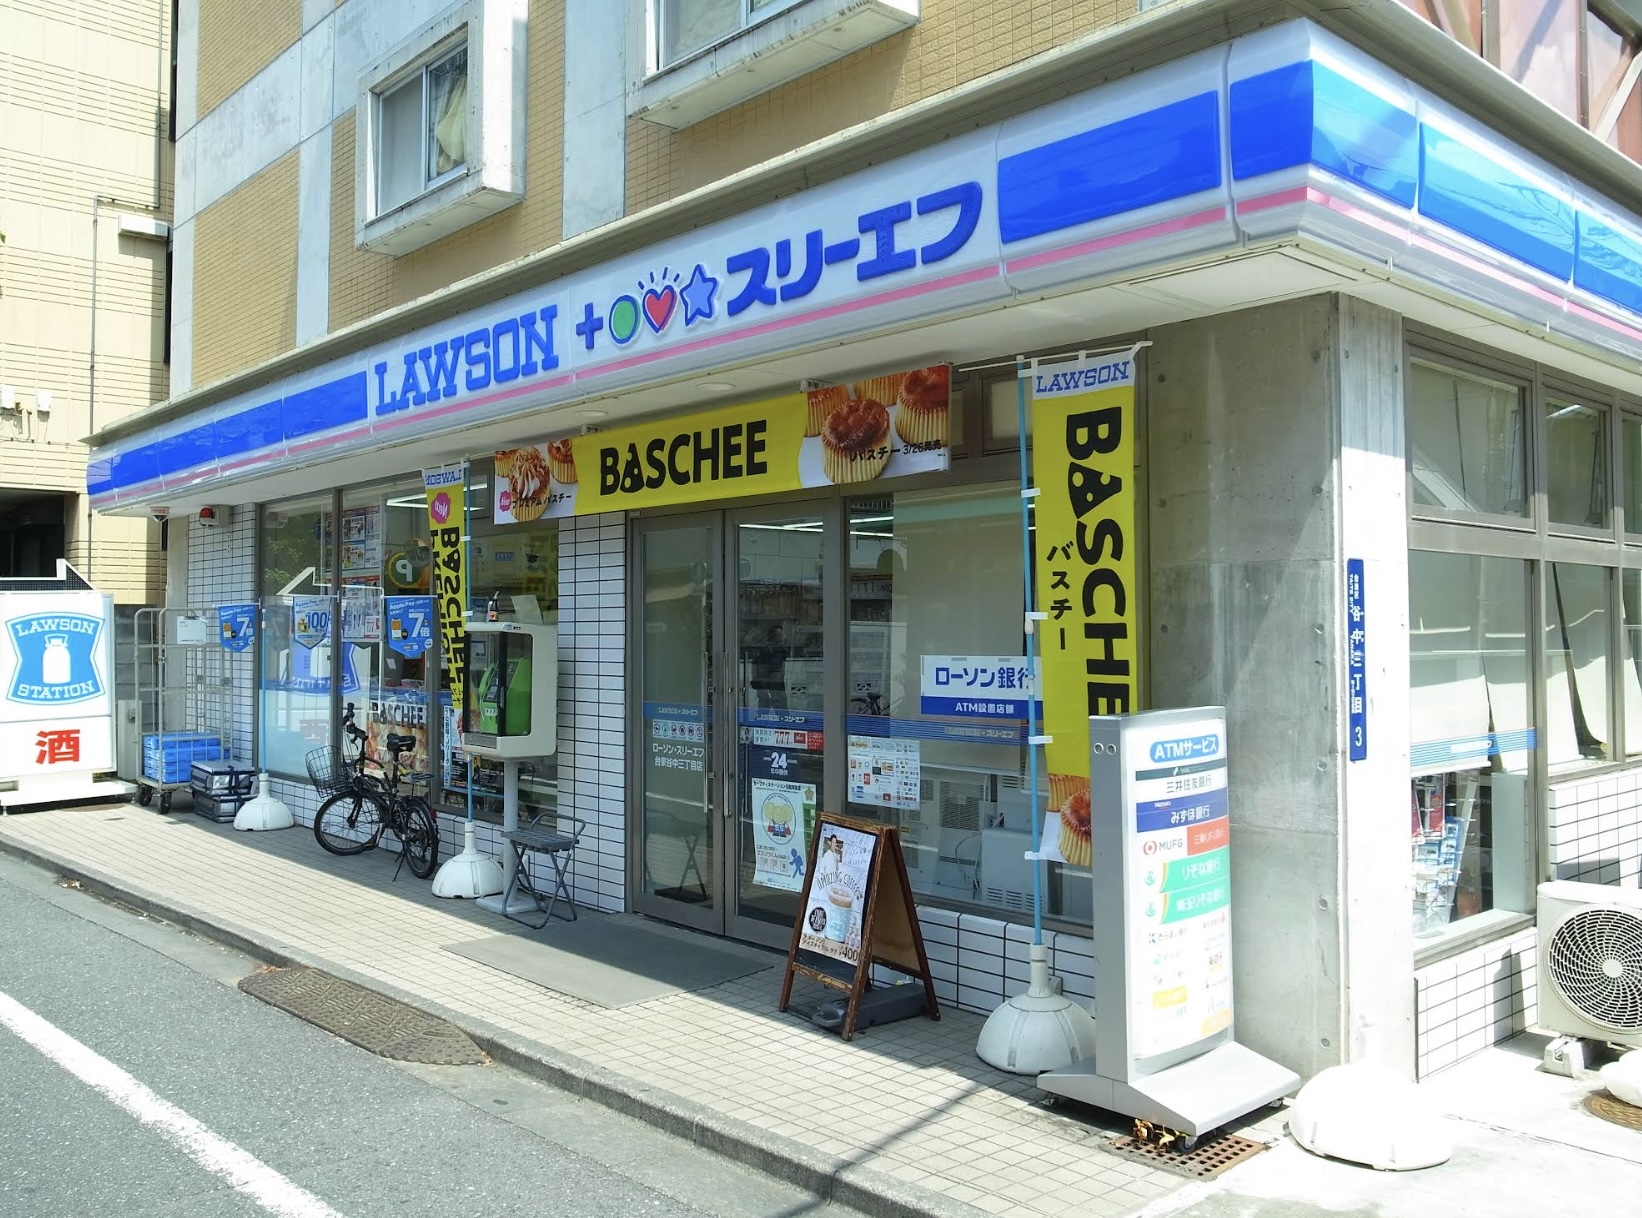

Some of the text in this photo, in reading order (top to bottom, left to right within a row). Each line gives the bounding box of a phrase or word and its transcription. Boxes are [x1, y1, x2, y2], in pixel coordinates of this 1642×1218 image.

[374, 304, 559, 417] LAWSON
[727, 180, 984, 318] スリーエフ
[1036, 360, 1130, 393] LAWSON
[600, 419, 768, 496] BASCHEE
[850, 446, 900, 462] バスチー
[1065, 405, 1131, 716] BASCHE
[1046, 541, 1074, 650] バスチー
[15, 618, 96, 636] LAWSON
[18, 680, 94, 699] STATION
[955, 702, 1014, 714] ATM設置店舗
[1355, 726, 1362, 746] 3
[35, 729, 80, 764] 酒
[1154, 737, 1216, 759] ATMサービス
[771, 752, 787, 768] 24
[1171, 805, 1210, 824] みずほ銀行
[1159, 838, 1183, 851] MUFG
